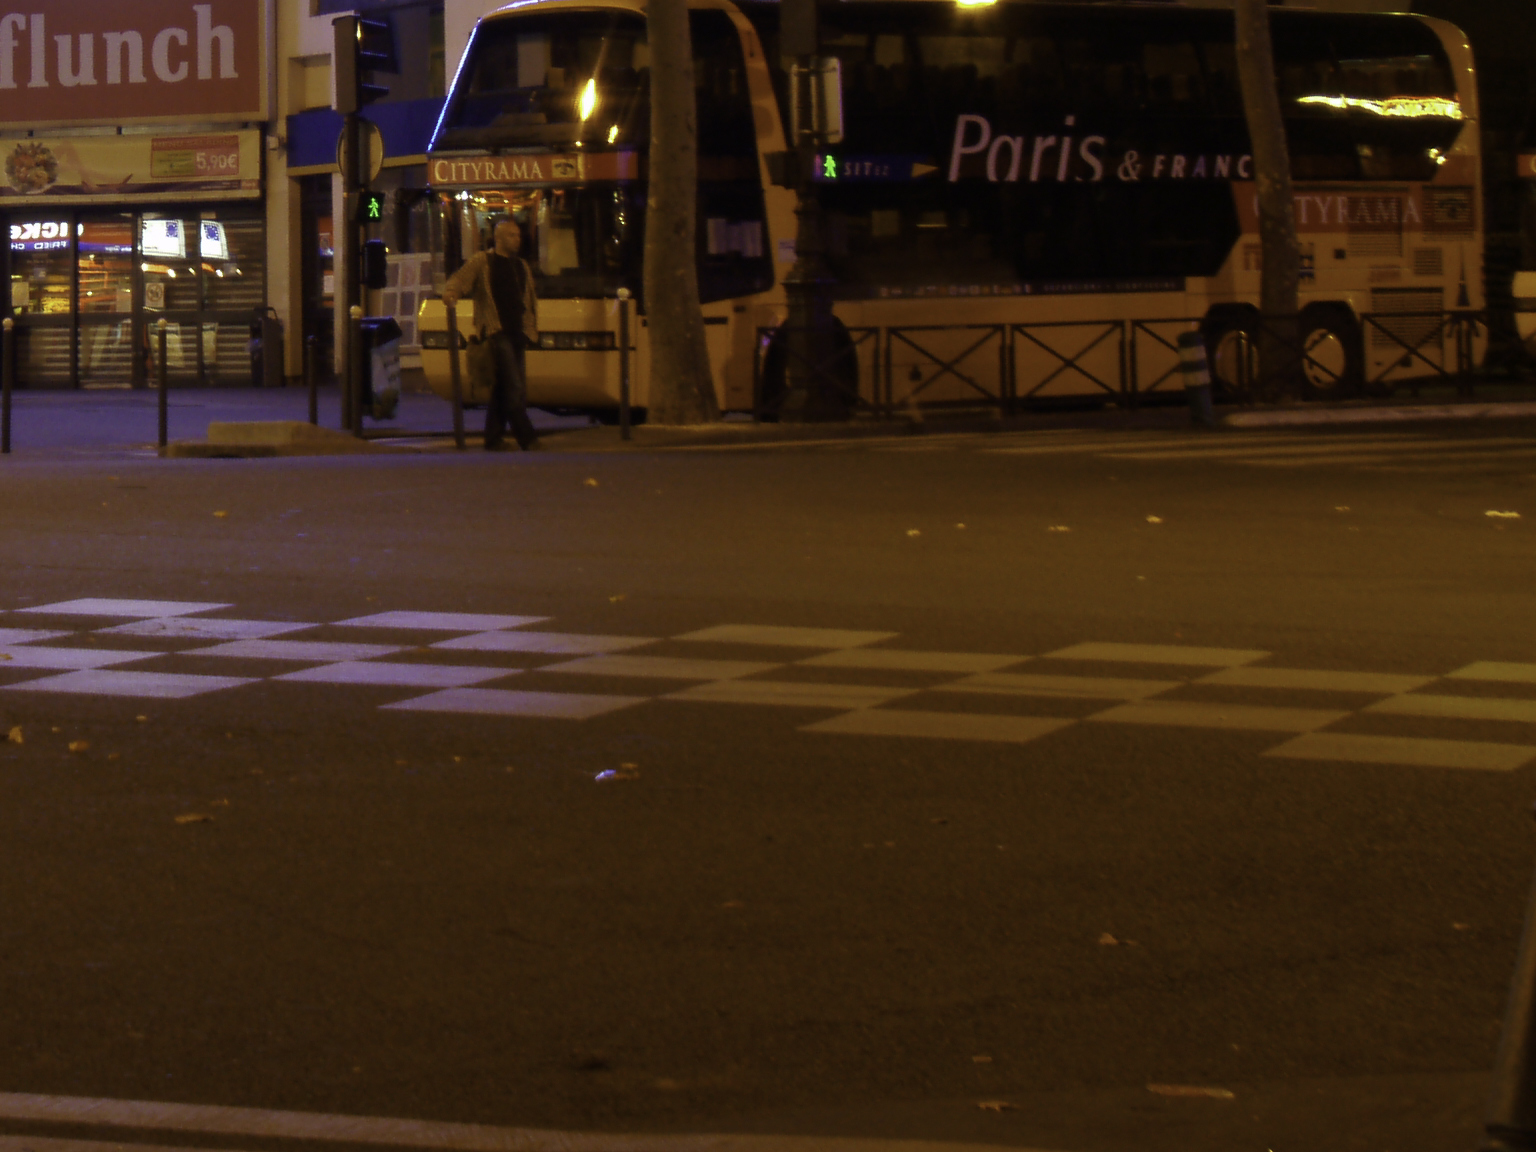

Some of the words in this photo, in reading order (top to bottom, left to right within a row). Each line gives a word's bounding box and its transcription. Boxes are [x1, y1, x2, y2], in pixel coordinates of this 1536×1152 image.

[948, 114, 1107, 183] Paris
[1117, 150, 1143, 181] &
[1151, 154, 1254, 179] FRANC
[195, 152, 238, 171] 5,90€
[433, 159, 544, 183] CITYRAMA
